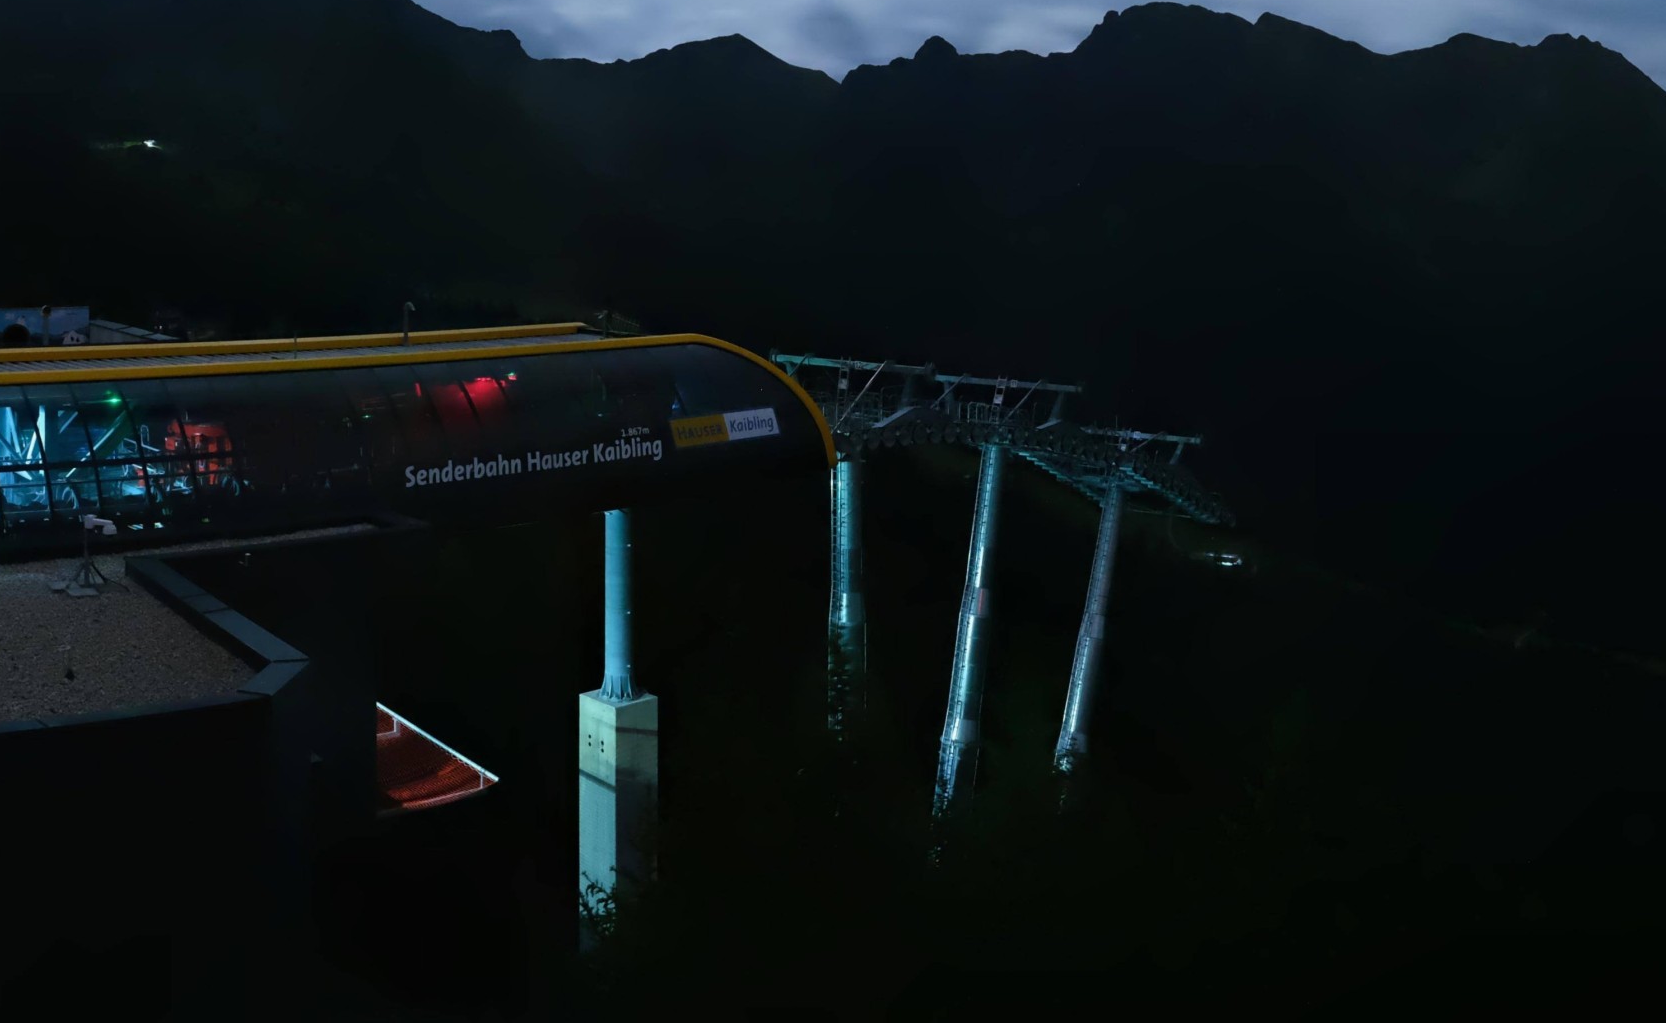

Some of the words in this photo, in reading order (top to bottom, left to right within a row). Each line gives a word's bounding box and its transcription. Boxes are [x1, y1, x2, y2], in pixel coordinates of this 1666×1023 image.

[621, 427, 650, 437] 1.867m
[677, 424, 723, 440] HAUSER
[730, 417, 774, 434] Kaibling
[405, 454, 522, 488] Senderbahn
[527, 448, 589, 473] Hauser
[593, 437, 662, 461] Kaibling
